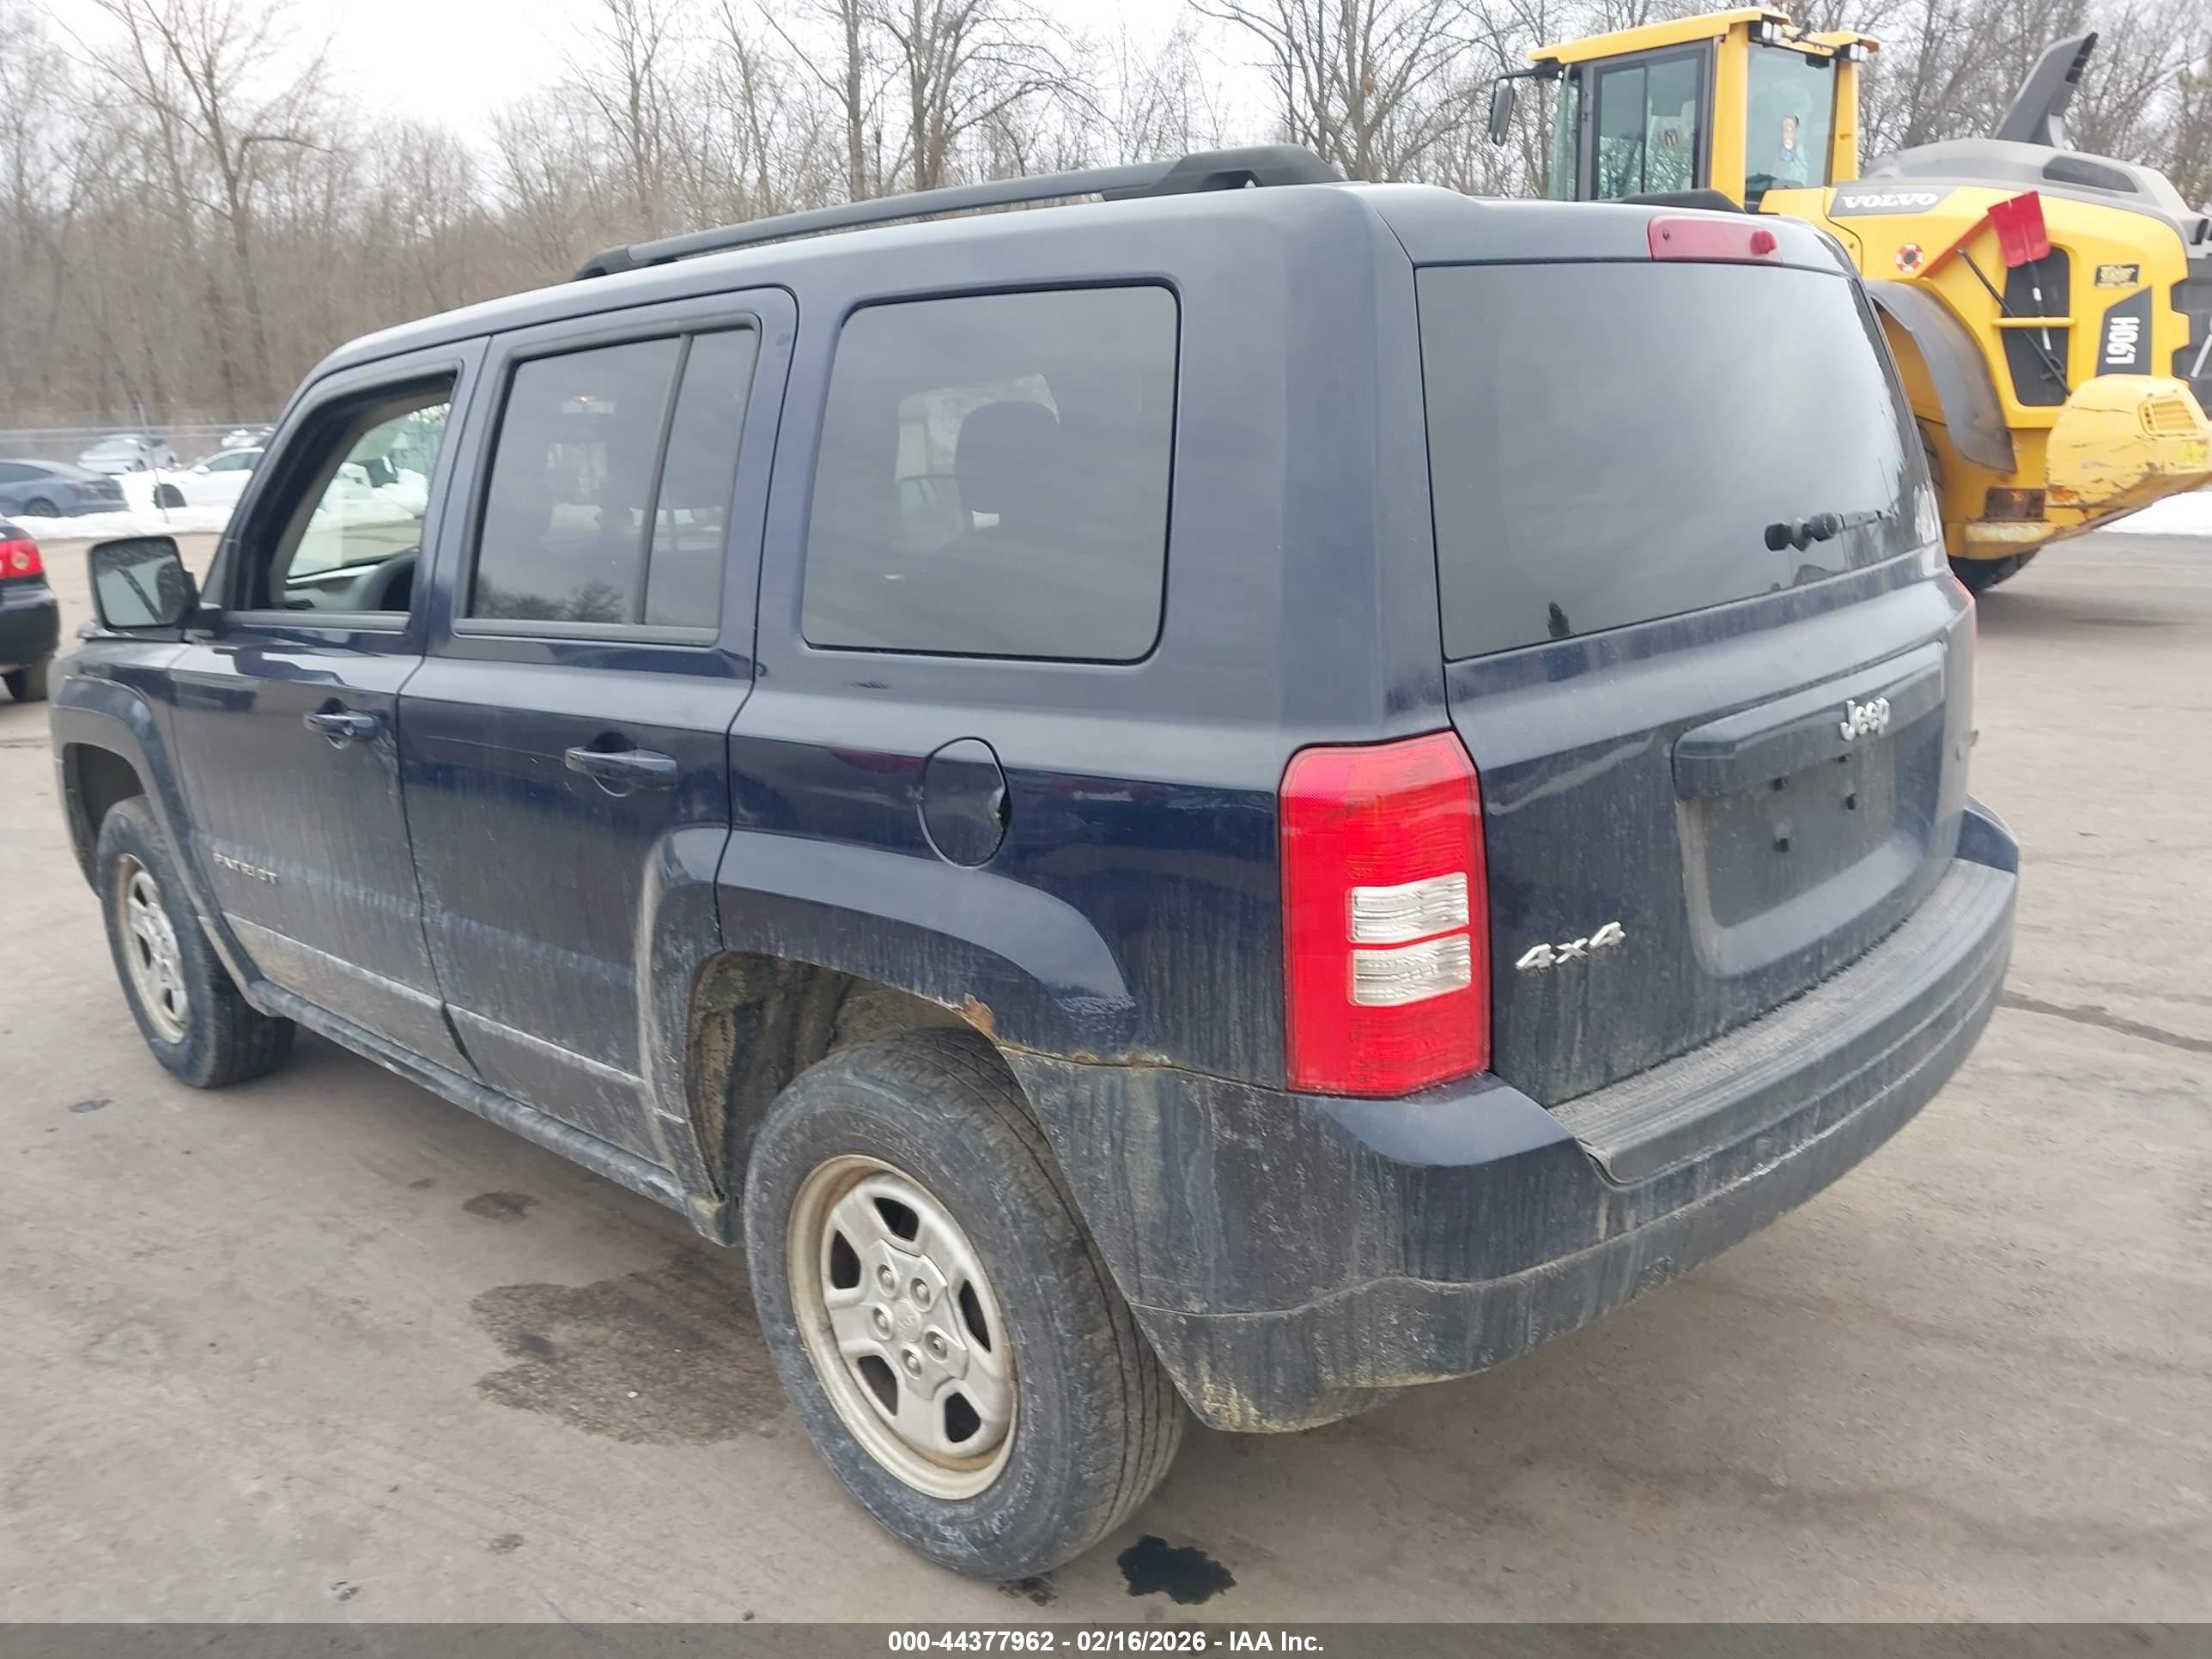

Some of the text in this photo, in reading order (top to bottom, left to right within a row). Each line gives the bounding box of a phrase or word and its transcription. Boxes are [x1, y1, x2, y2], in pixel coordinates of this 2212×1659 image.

[1840, 193, 1938, 209] VOLVO
[2105, 316, 2141, 364] L90H
[1839, 697, 1890, 741] Jeep
[212, 852, 278, 884] PATRIOT
[1515, 921, 1626, 970] 4x4
